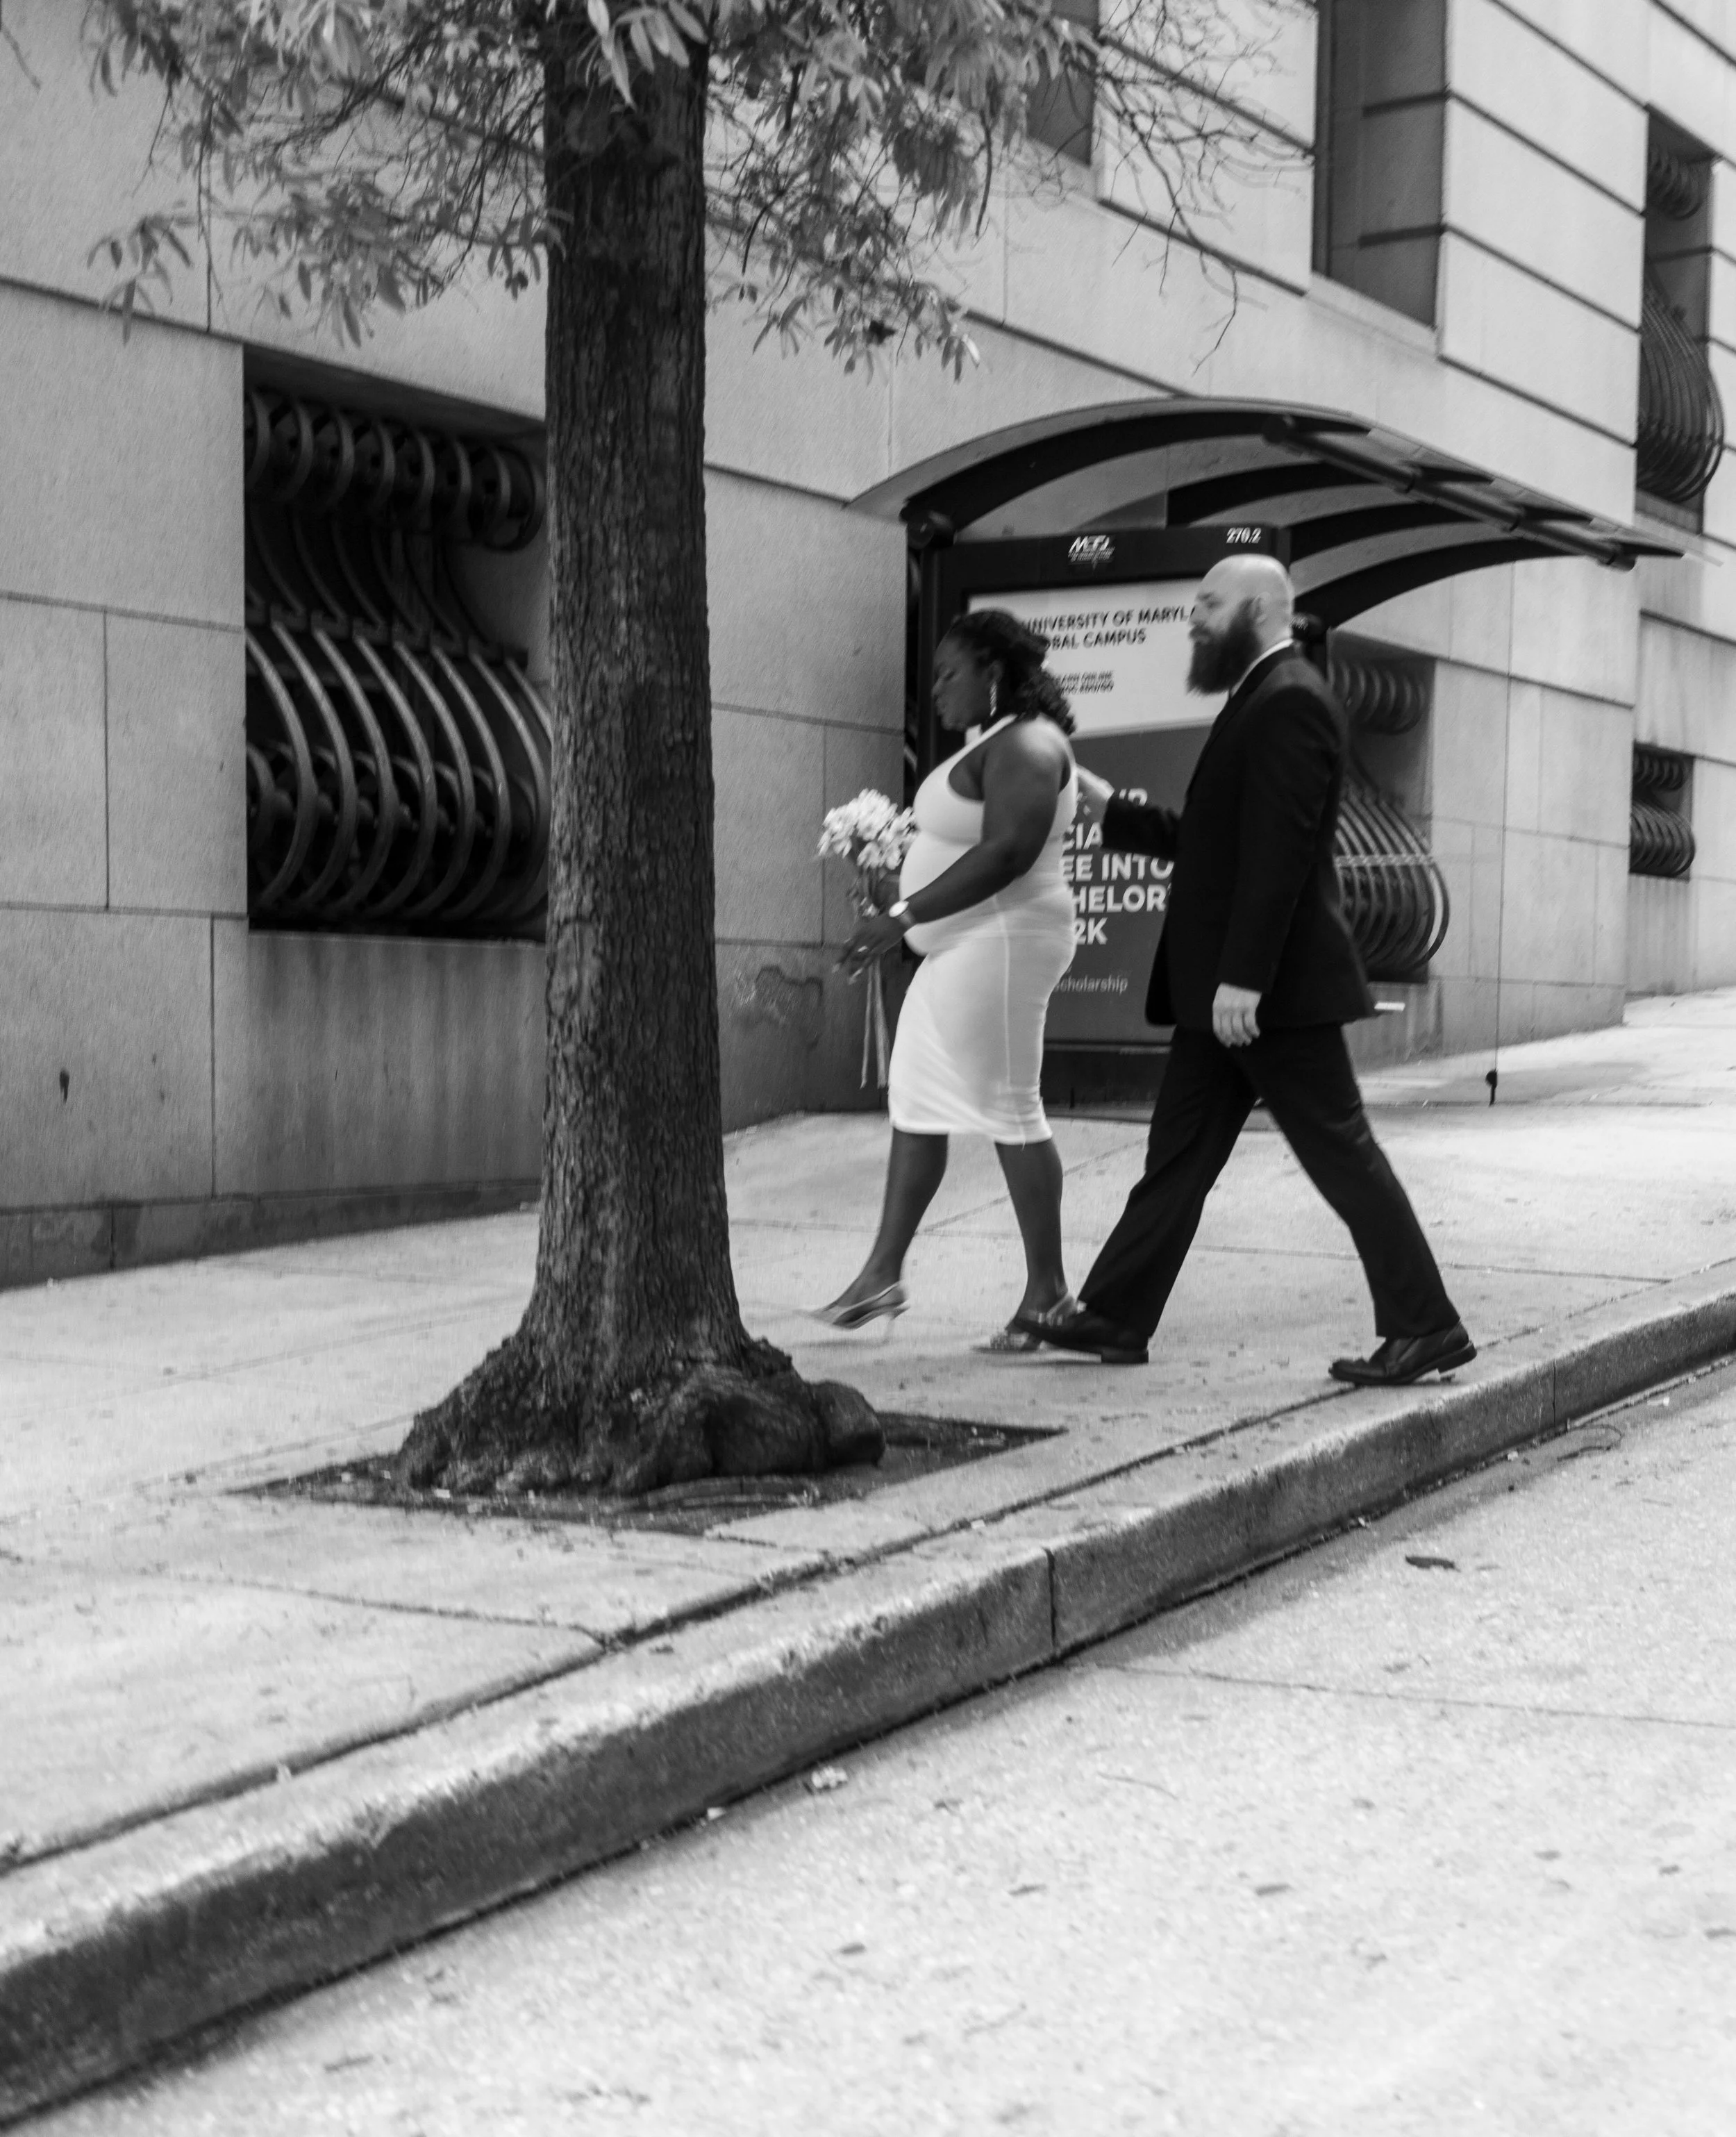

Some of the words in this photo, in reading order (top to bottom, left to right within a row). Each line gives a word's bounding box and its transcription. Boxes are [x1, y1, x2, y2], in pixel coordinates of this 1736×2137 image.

[1112, 608, 1135, 628] OF
[1137, 605, 1196, 625] MARYL
[1083, 627, 1147, 649] CAMPUS
[1074, 916, 1109, 946] 2K
